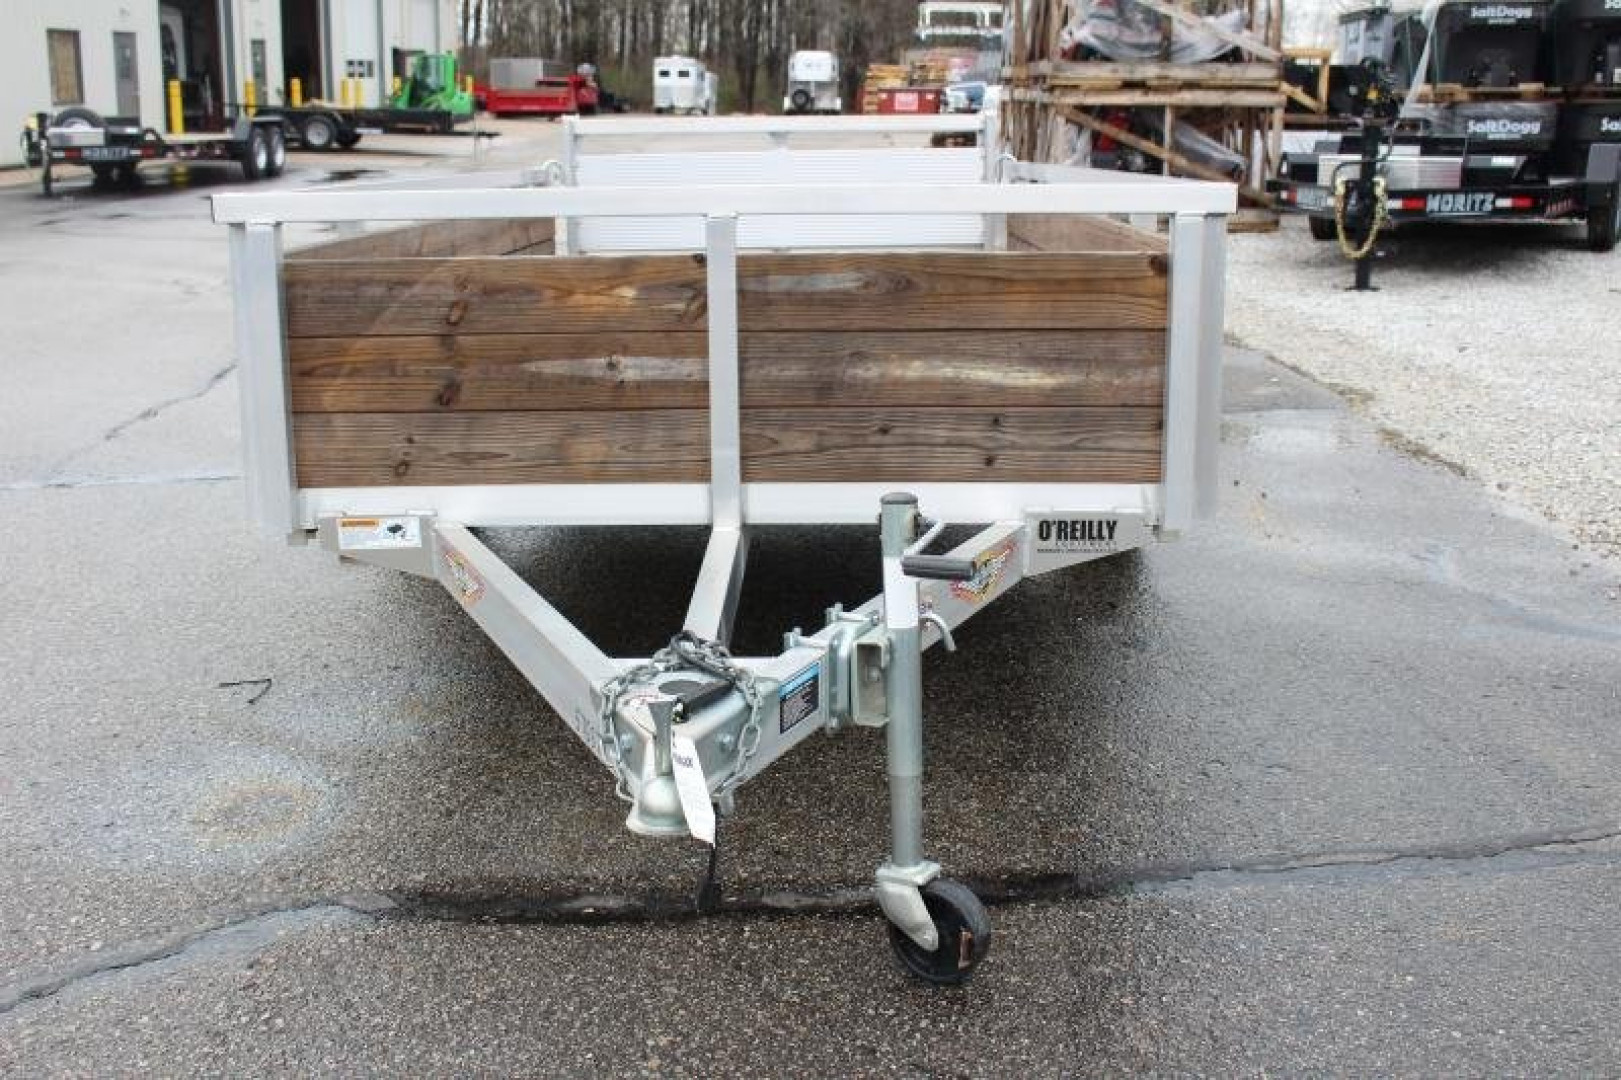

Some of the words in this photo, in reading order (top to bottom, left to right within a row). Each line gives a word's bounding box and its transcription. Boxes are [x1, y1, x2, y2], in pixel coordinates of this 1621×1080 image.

[1467, 119, 1541, 134] SaltDogg
[1426, 193, 1495, 212] MORITZ
[1038, 520, 1118, 541] O'REILLY
